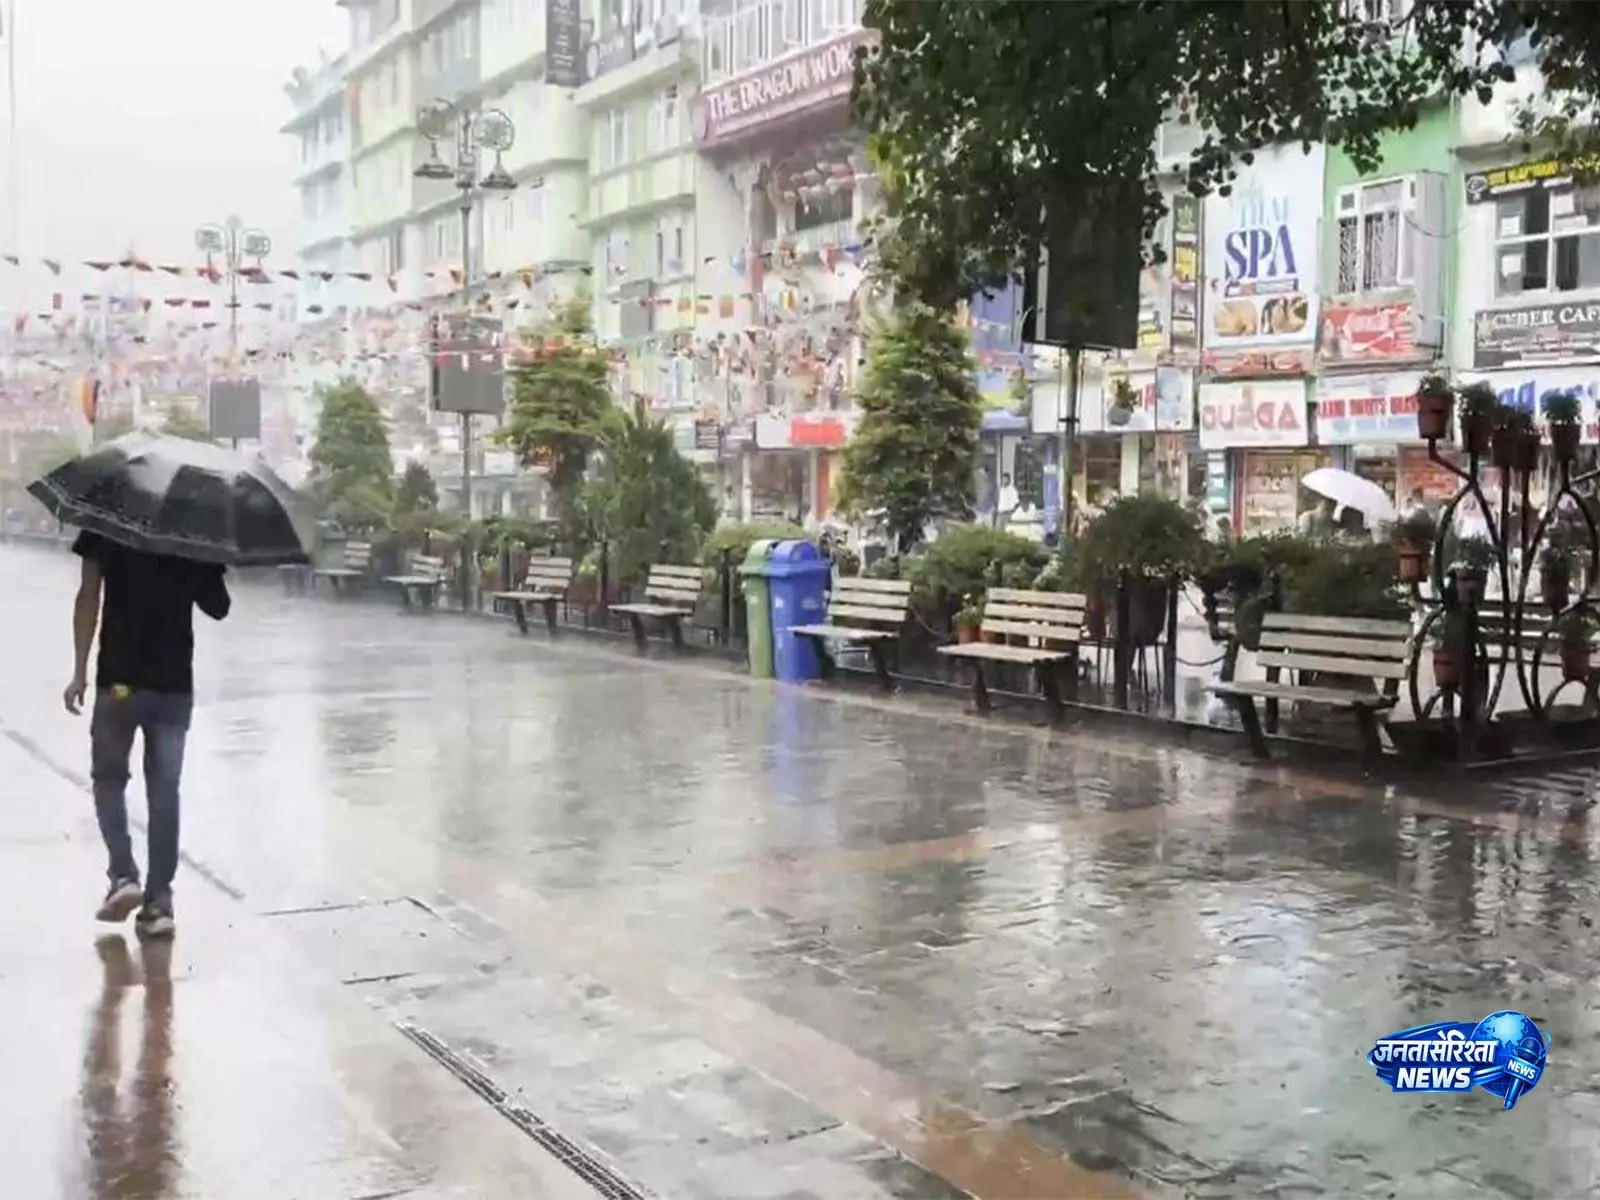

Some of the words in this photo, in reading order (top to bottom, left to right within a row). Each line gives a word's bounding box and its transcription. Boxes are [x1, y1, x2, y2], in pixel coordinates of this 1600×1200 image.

[707, 88, 740, 121] THE
[740, 61, 808, 109] DRAGON
[1224, 224, 1297, 279] SPA
